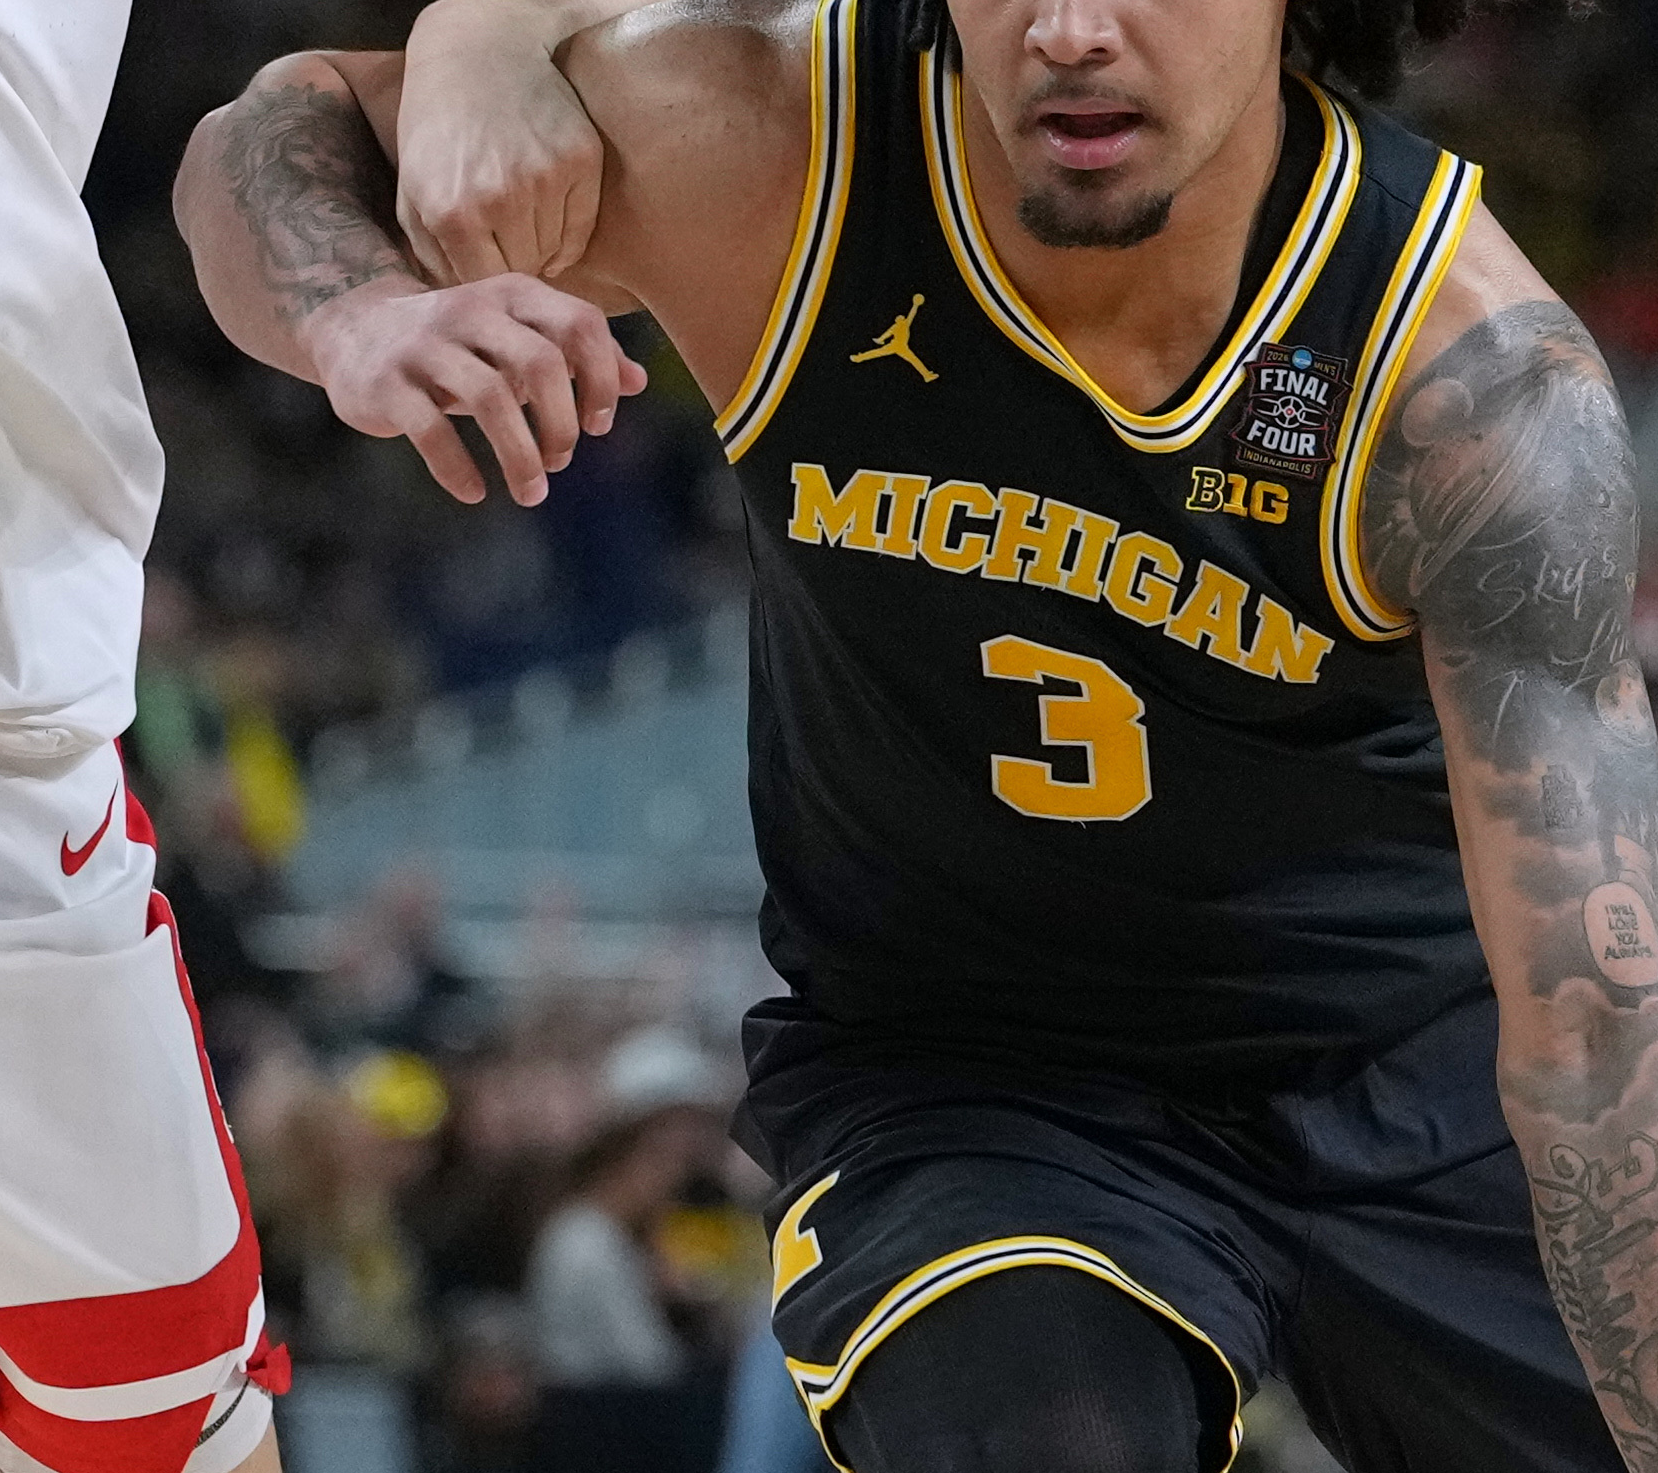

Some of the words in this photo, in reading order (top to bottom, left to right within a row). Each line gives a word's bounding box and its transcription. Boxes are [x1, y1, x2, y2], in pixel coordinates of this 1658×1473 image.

[1260, 367, 1330, 406] FINAL
[1246, 419, 1318, 457] FOUR
[1242, 449, 1313, 475] INDIANAPOLIS
[788, 462, 1335, 685] MICHIGAN
[979, 633, 1154, 823] 3
